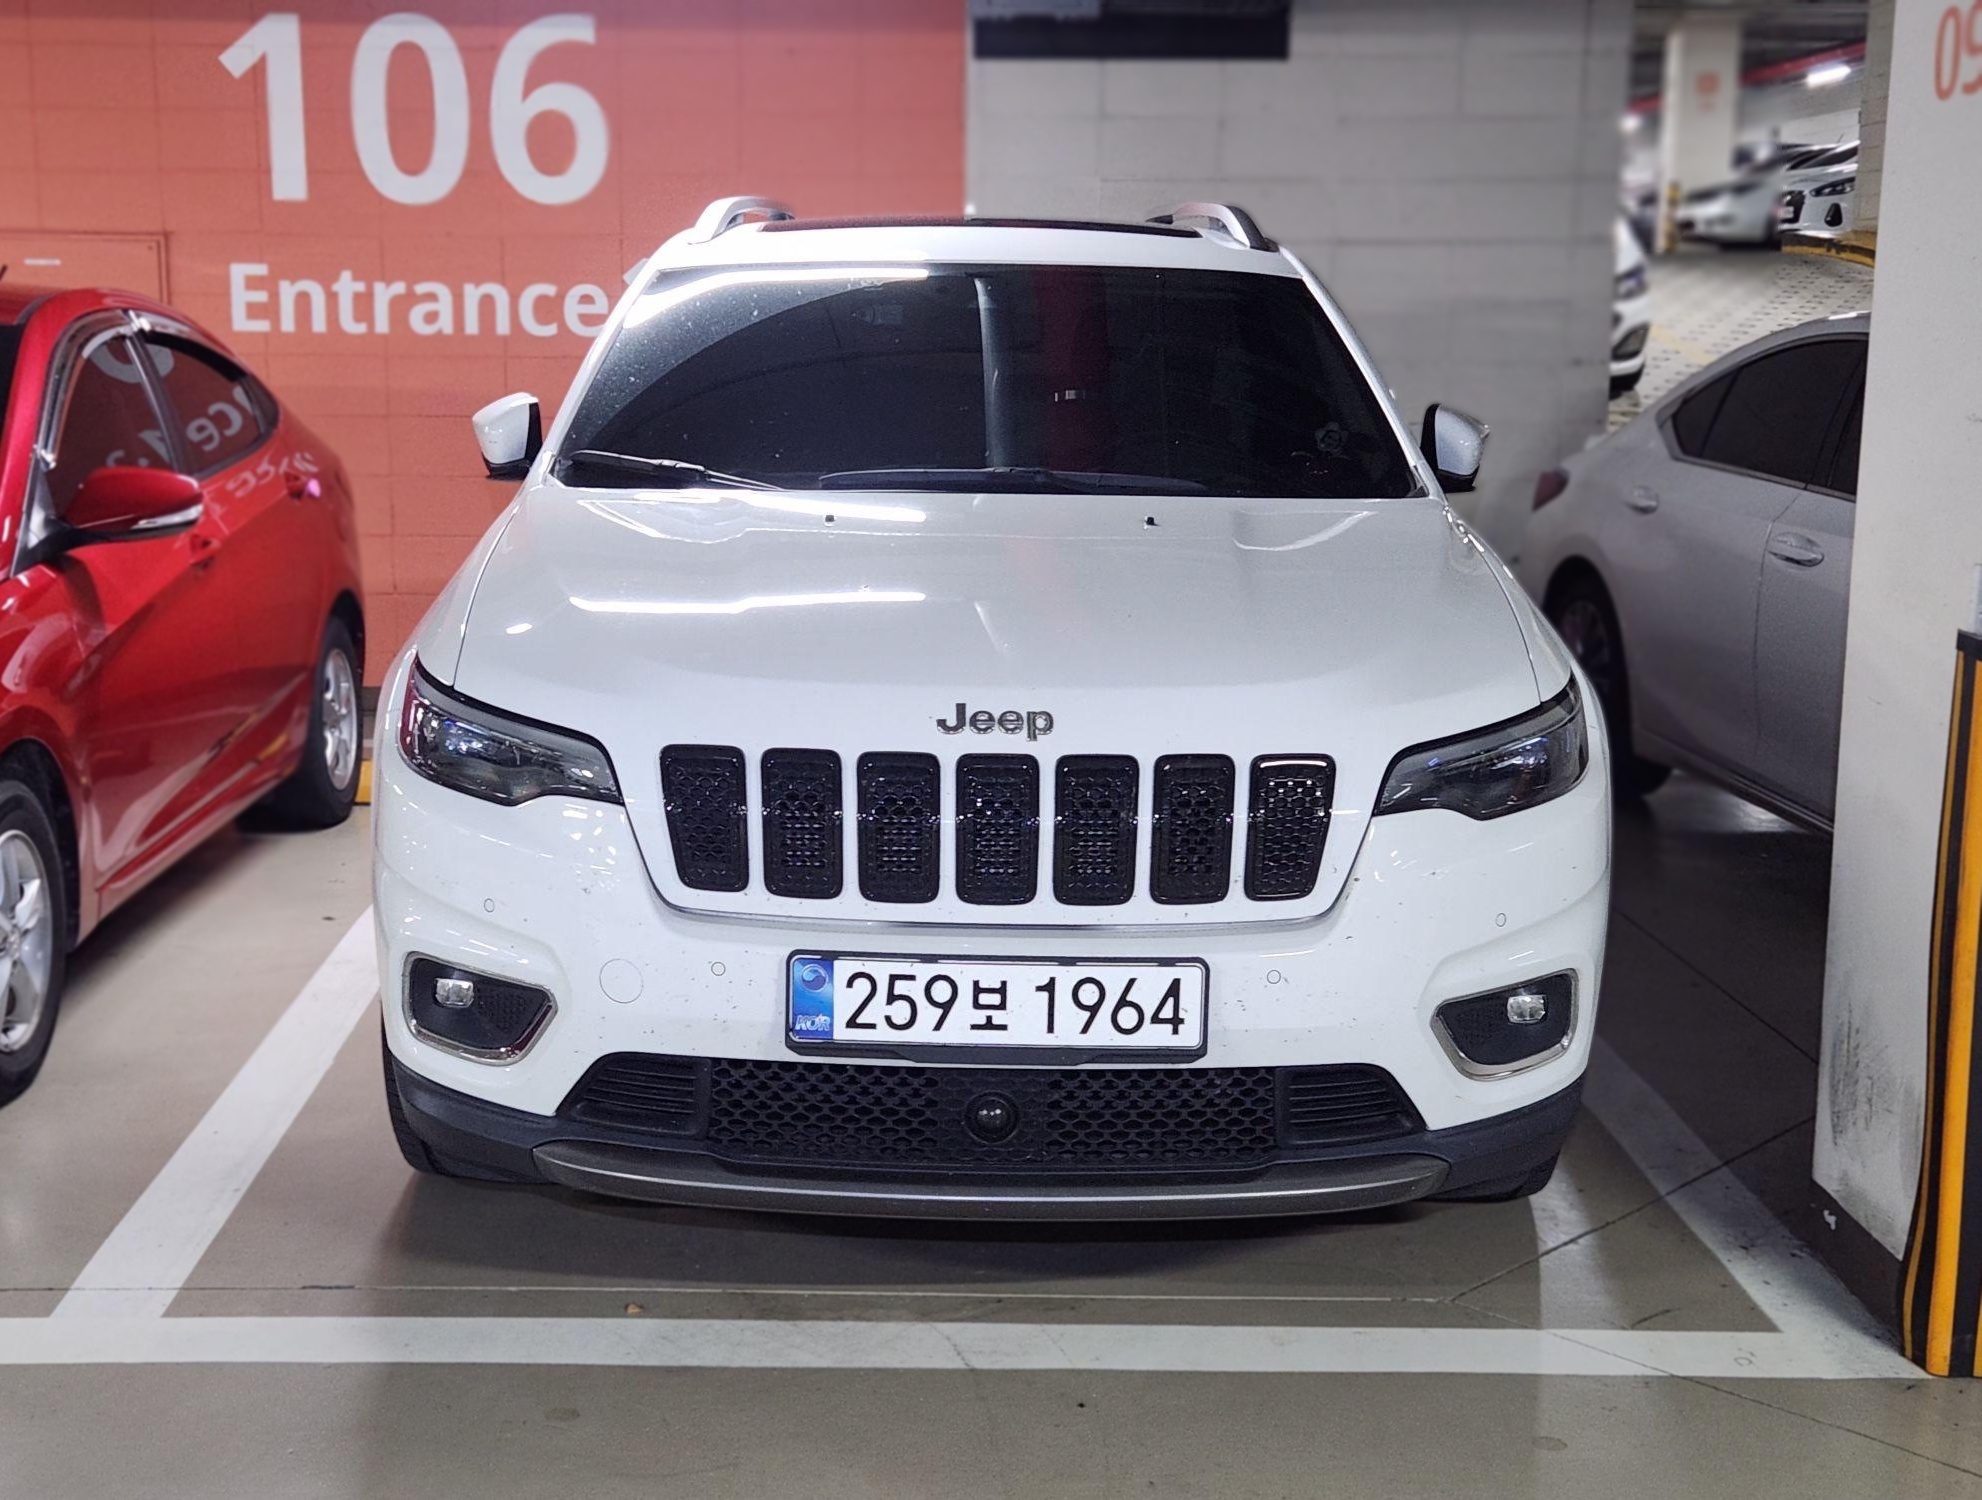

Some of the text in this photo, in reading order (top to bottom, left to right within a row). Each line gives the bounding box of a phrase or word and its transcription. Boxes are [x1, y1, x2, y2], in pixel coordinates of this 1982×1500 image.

[218, 12, 609, 205] 106
[229, 262, 610, 337] Entrance
[936, 702, 1054, 741] Jeep
[795, 1014, 831, 1031] KOR
[845, 971, 1185, 1035] 259보 1964
